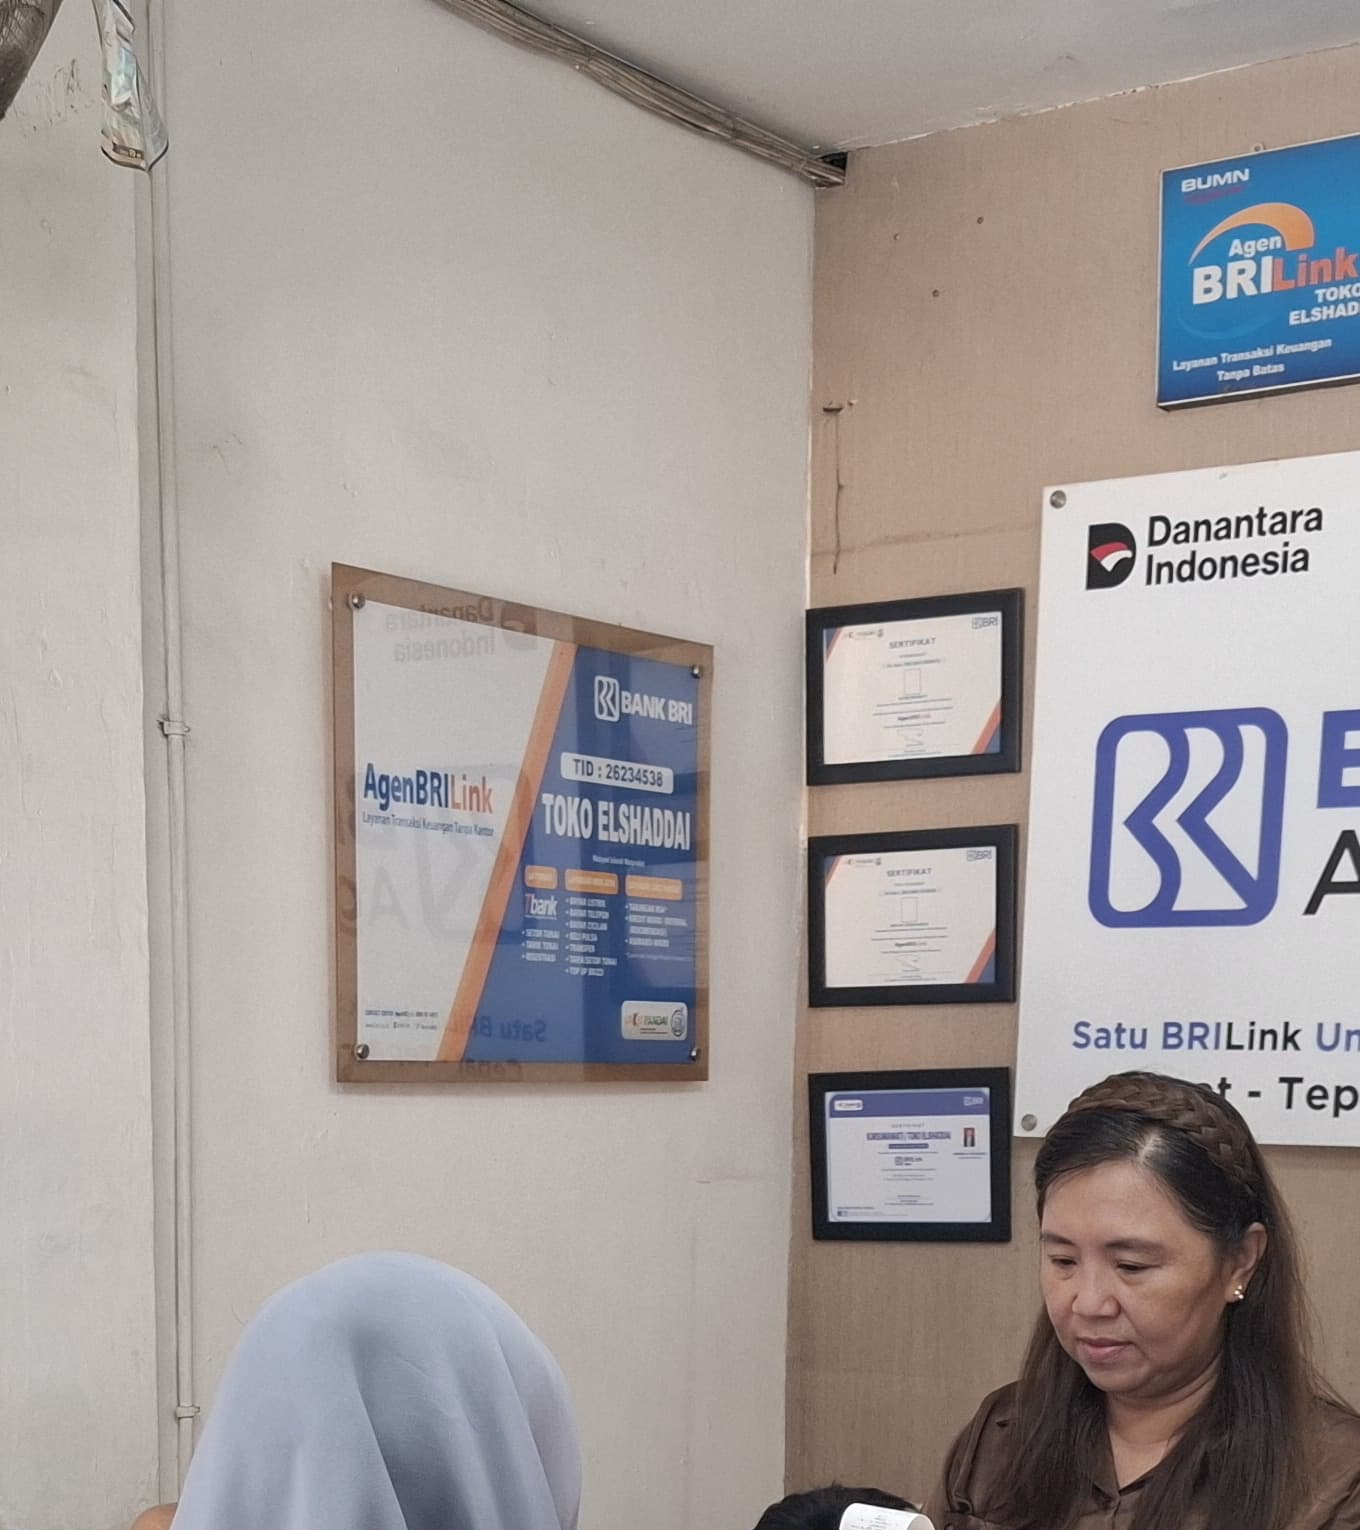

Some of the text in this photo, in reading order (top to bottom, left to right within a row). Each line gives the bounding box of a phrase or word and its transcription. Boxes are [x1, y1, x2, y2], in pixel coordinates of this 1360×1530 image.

[1181, 168, 1249, 193] BUMN
[1228, 236, 1282, 259] Agen
[1193, 247, 1359, 305] BRILink
[1172, 338, 1332, 373] Layanan Transaksi Keuangan
[1217, 363, 1285, 382] Tanpa Batas
[1145, 503, 1325, 547] Danantara
[1144, 543, 1311, 586] Indonesia
[620, 690, 693, 726] BANK BRI
[363, 762, 494, 814] AgenBRILink
[572, 758, 664, 787] TID 26234538
[542, 793, 691, 851] TOKO ELSHADDAI
[1072, 1020, 1148, 1050] Satu
[1161, 1020, 1302, 1052] BRILink
